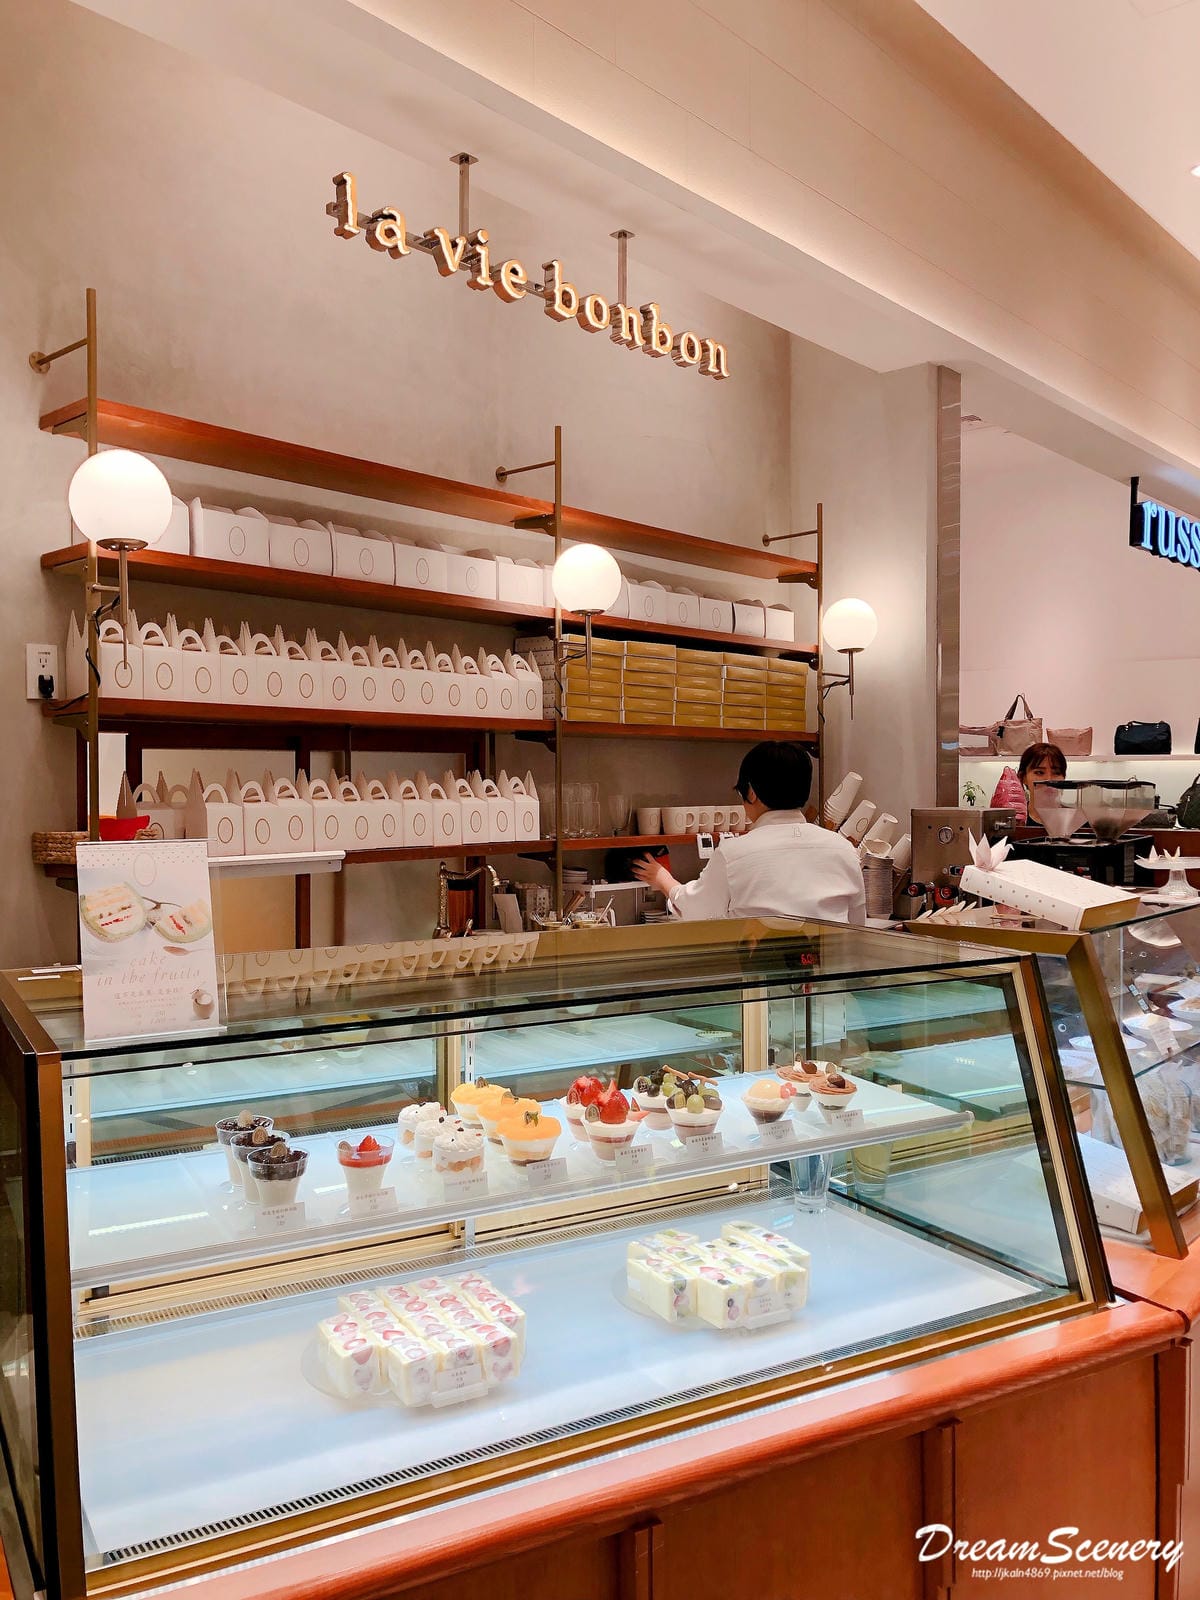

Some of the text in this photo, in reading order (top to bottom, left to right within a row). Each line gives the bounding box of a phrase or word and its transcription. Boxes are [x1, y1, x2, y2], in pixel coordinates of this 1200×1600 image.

[331, 171, 731, 380] la vie bonbon
